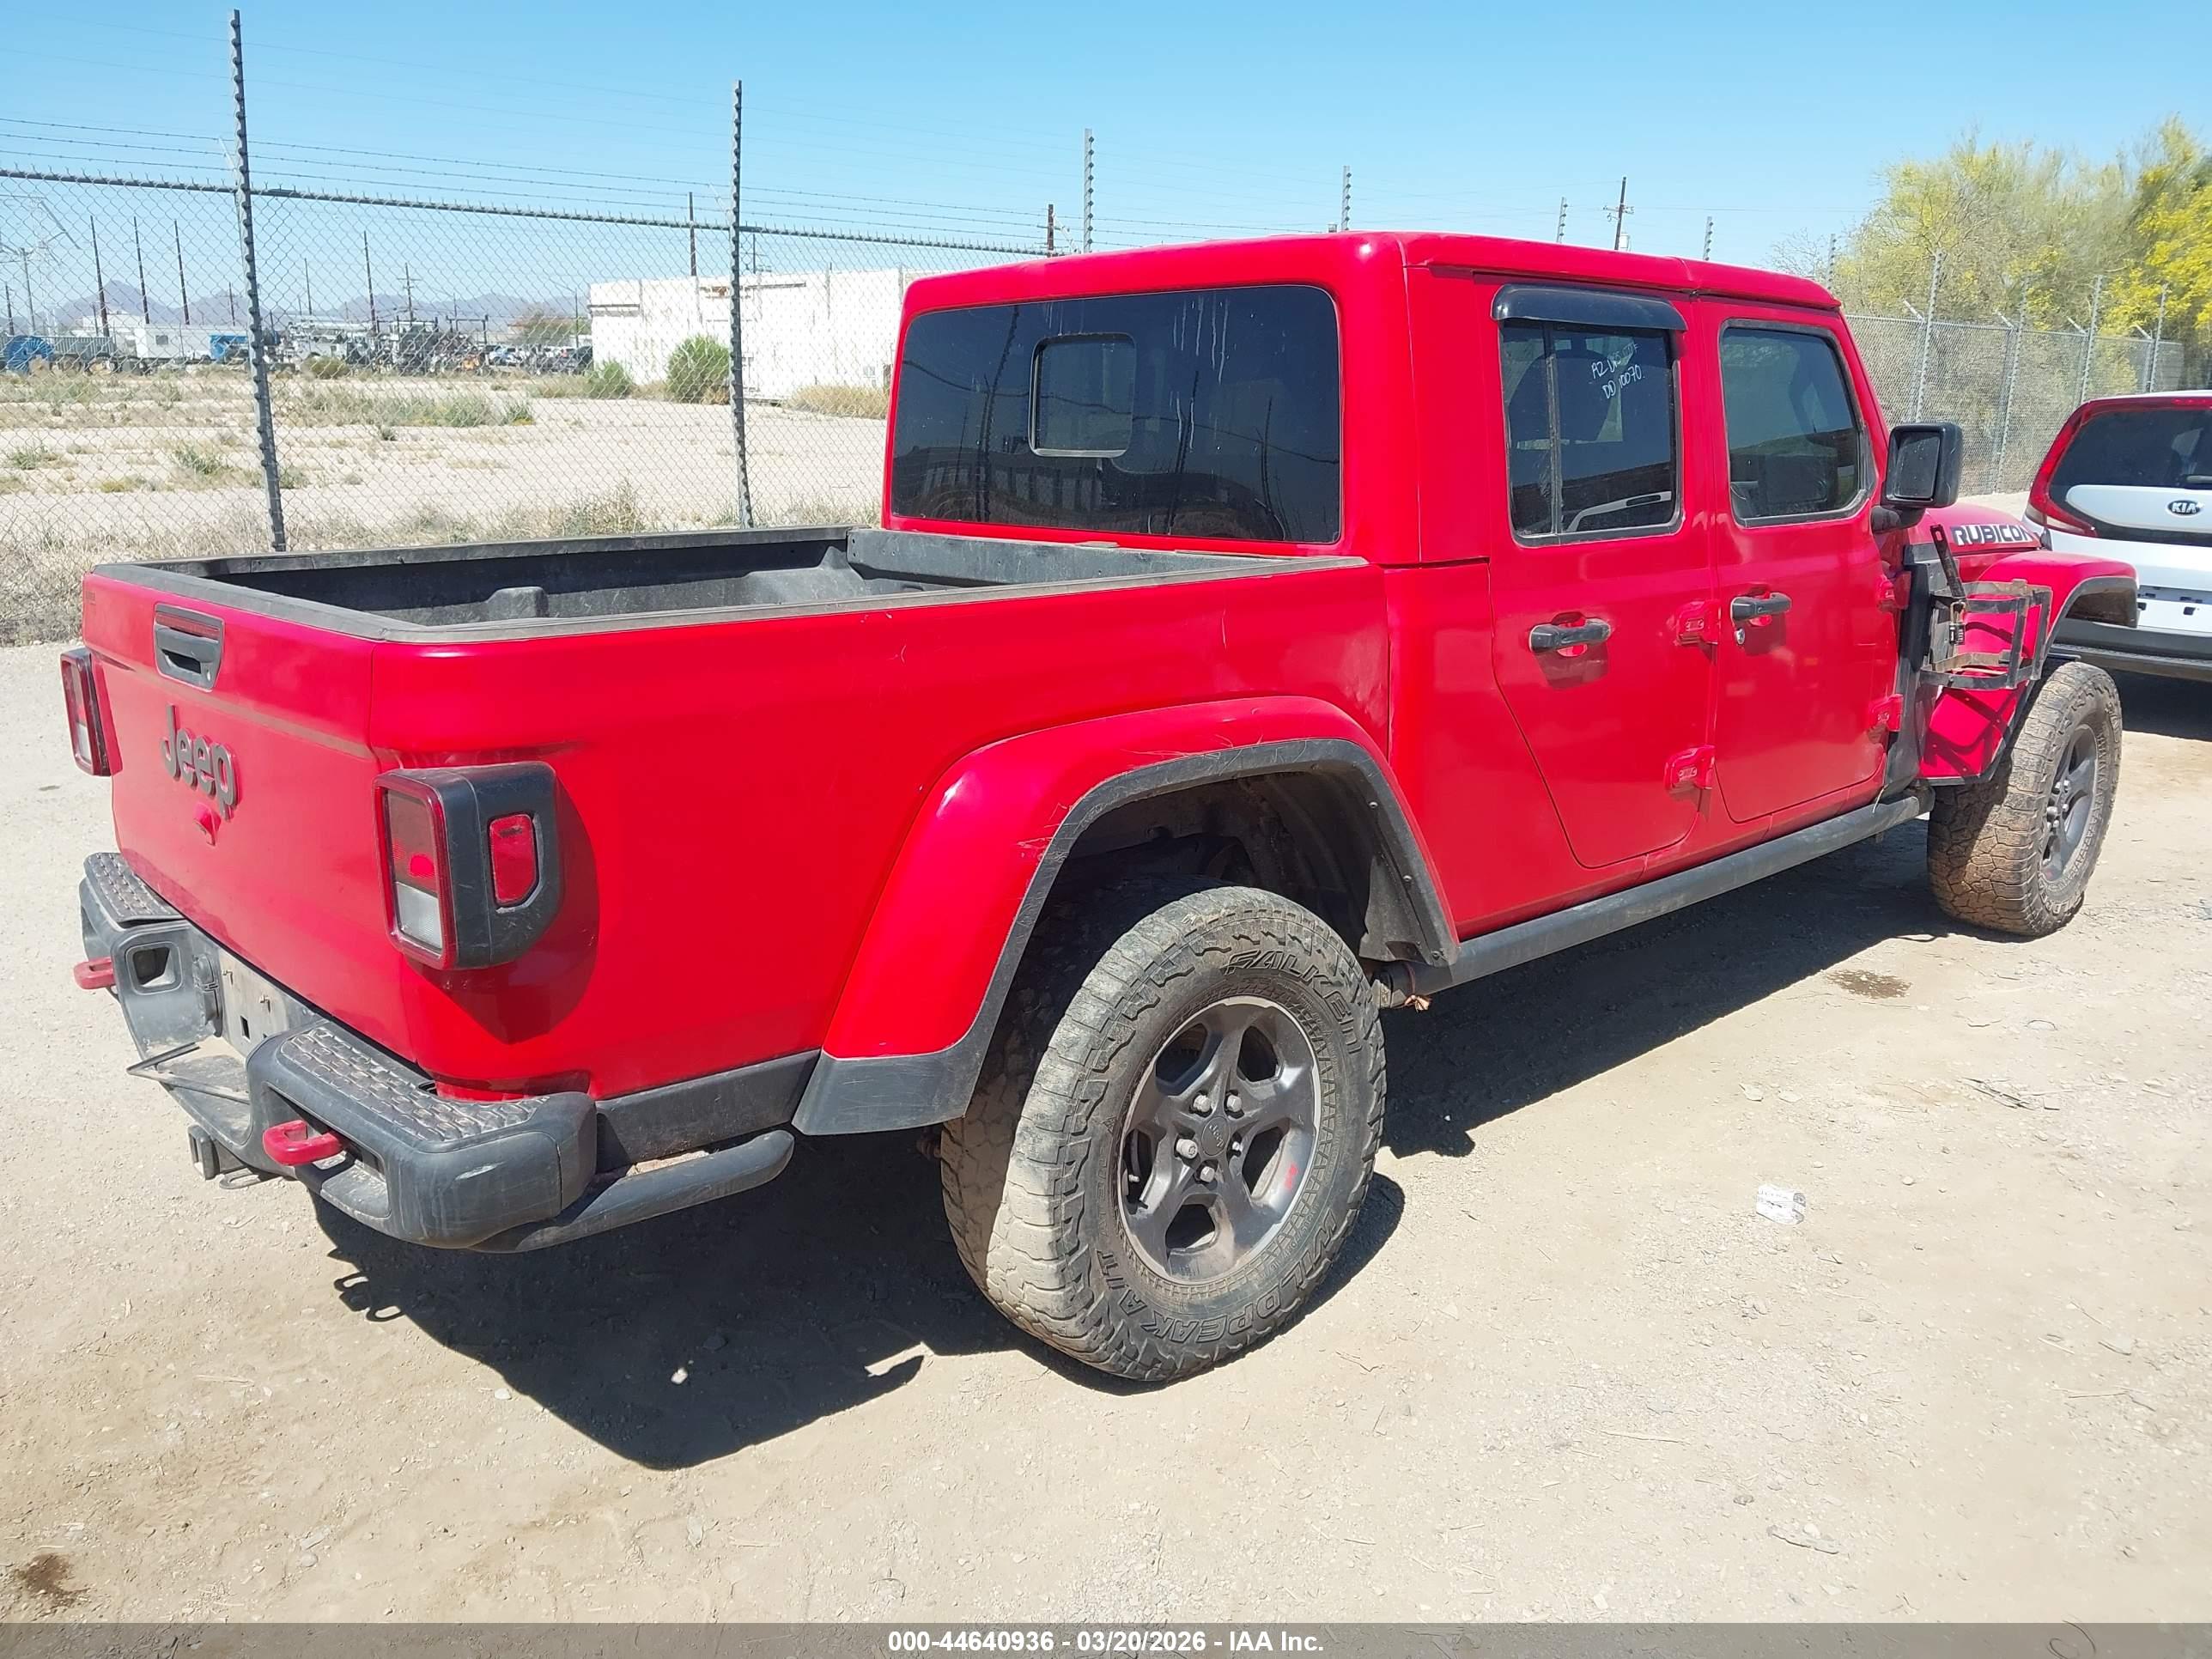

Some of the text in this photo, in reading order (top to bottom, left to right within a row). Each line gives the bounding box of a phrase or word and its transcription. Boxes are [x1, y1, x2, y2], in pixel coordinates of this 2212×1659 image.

[160, 703, 235, 822] Jeep
[1221, 949, 1363, 1055] FALKEN
[1140, 1207, 1337, 1343] WILDPEAK
